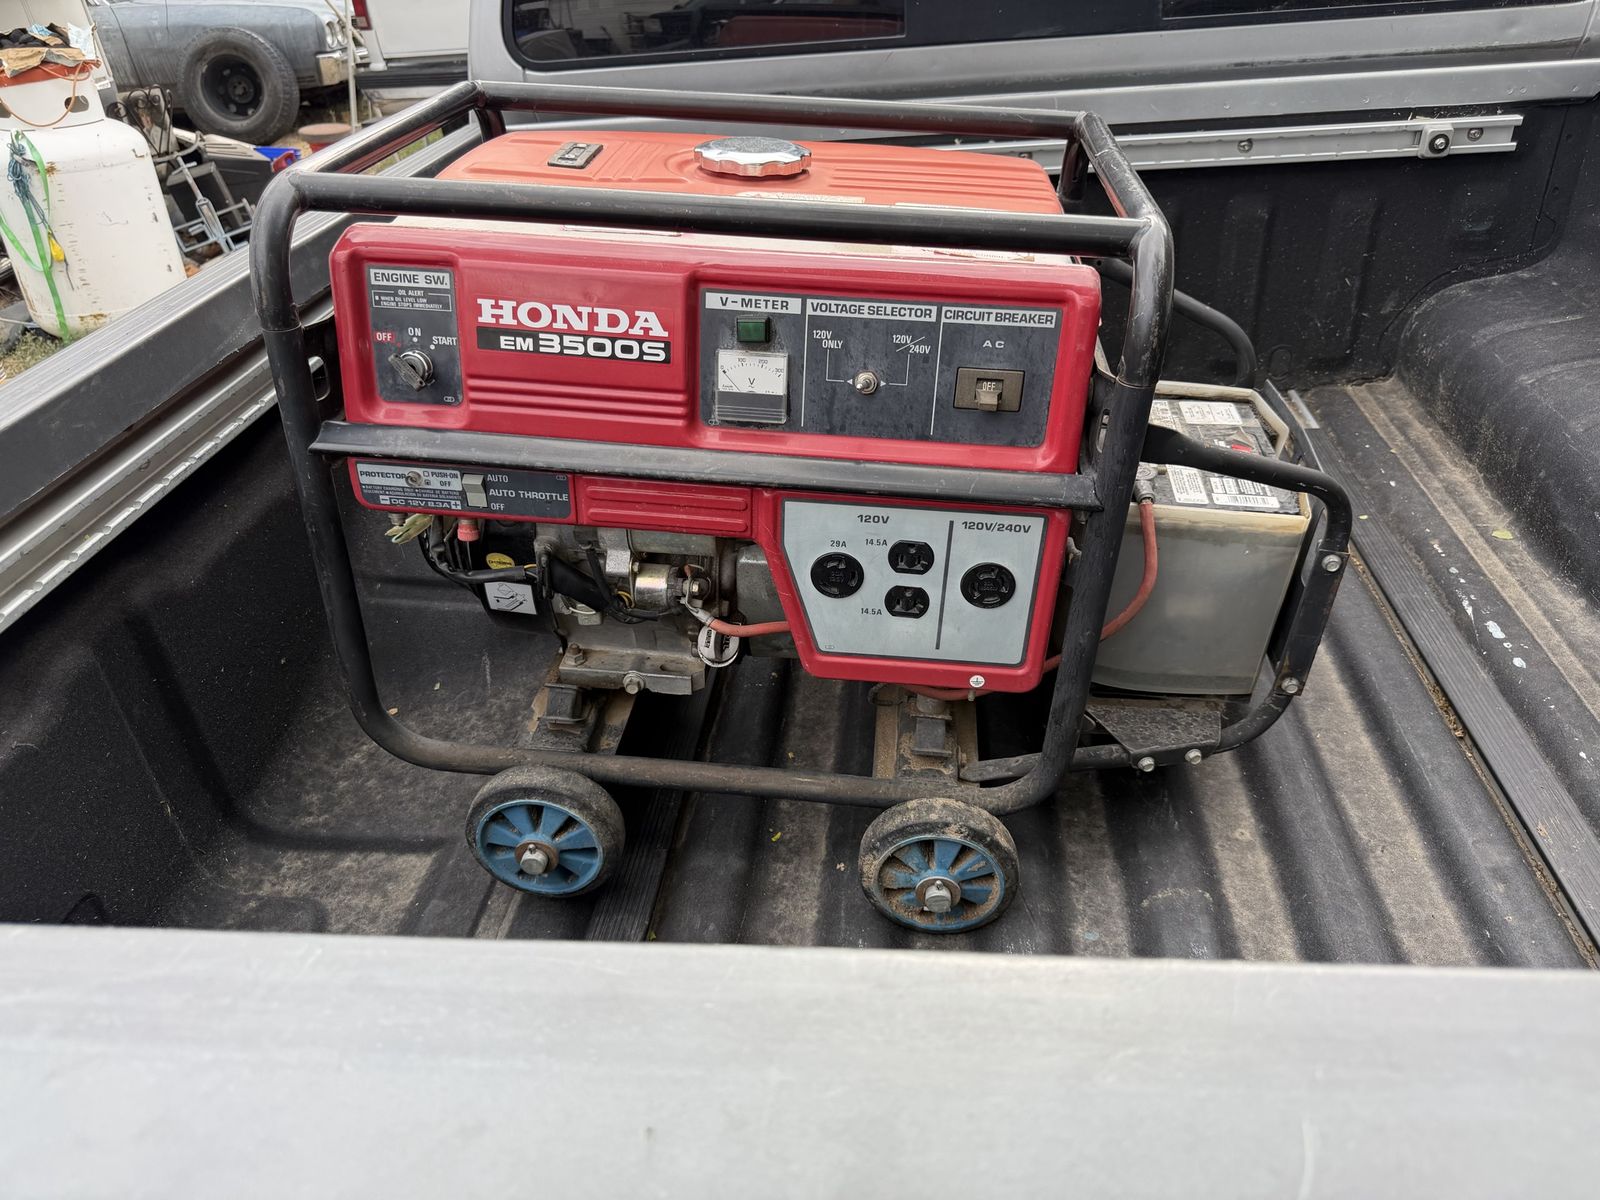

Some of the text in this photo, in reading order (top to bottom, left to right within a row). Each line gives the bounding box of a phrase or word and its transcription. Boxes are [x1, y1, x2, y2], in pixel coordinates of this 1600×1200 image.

[373, 271, 448, 286] ENGINE SW.
[397, 289, 407, 297] OIL
[720, 296, 789, 311] V-METER
[811, 302, 933, 319] VOLTAGE SELECTOR
[477, 298, 669, 338] HONDA
[944, 309, 1054, 325] CIRCUIT BREAKER
[376, 332, 393, 341] OFF
[408, 327, 421, 336] ON
[813, 330, 832, 340] 120V
[432, 335, 457, 346] START
[822, 340, 843, 349] ONLY
[500, 333, 666, 362] EM3500S
[748, 377, 756, 386] V
[982, 381, 996, 391] OFF
[360, 470, 406, 480] PROTECTOR
[431, 471, 459, 479] PUSH-ON
[487, 474, 509, 483] AUTO
[489, 488, 569, 501] AUTO THROTTLE
[491, 502, 504, 510] OFF
[857, 514, 889, 524] 120V
[961, 521, 1031, 533] 120V/240V
[830, 539, 847, 548] 29A
[865, 538, 888, 546] 14.5A
[861, 607, 882, 615] 14.5A
